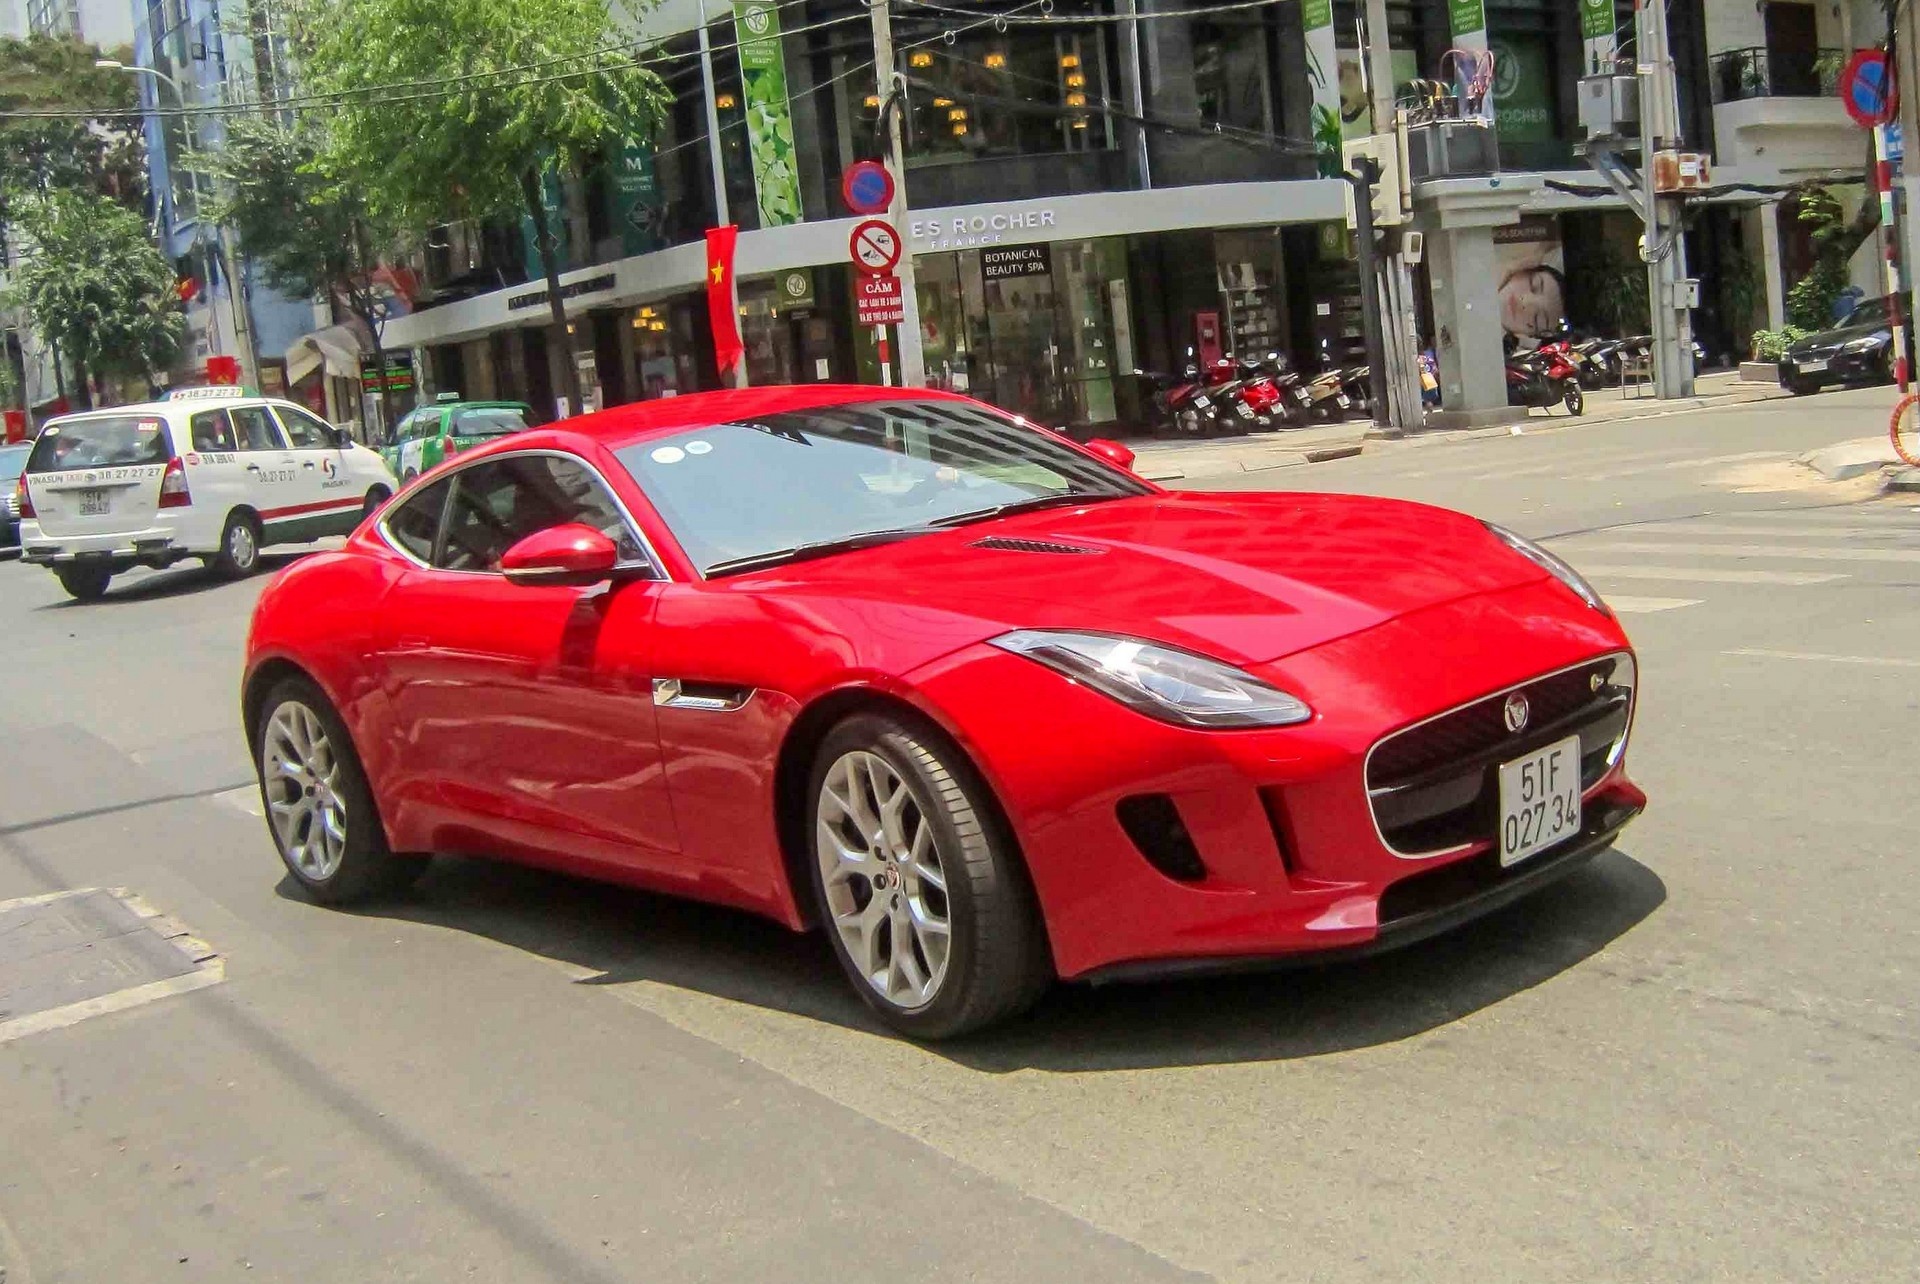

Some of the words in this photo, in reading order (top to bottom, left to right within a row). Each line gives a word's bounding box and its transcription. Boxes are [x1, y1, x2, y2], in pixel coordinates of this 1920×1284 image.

[953, 209, 1056, 235] ROCHER
[931, 234, 1001, 250] FRANCE
[985, 248, 1043, 264] BOTANICAL
[986, 263, 1024, 277] BEAUTY
[1027, 261, 1045, 274] SPA
[116, 470, 127, 479] 27
[131, 468, 143, 478] 27
[147, 467, 161, 477] 27
[1521, 750, 1562, 803] 51F
[1505, 789, 1577, 854] 027.34
